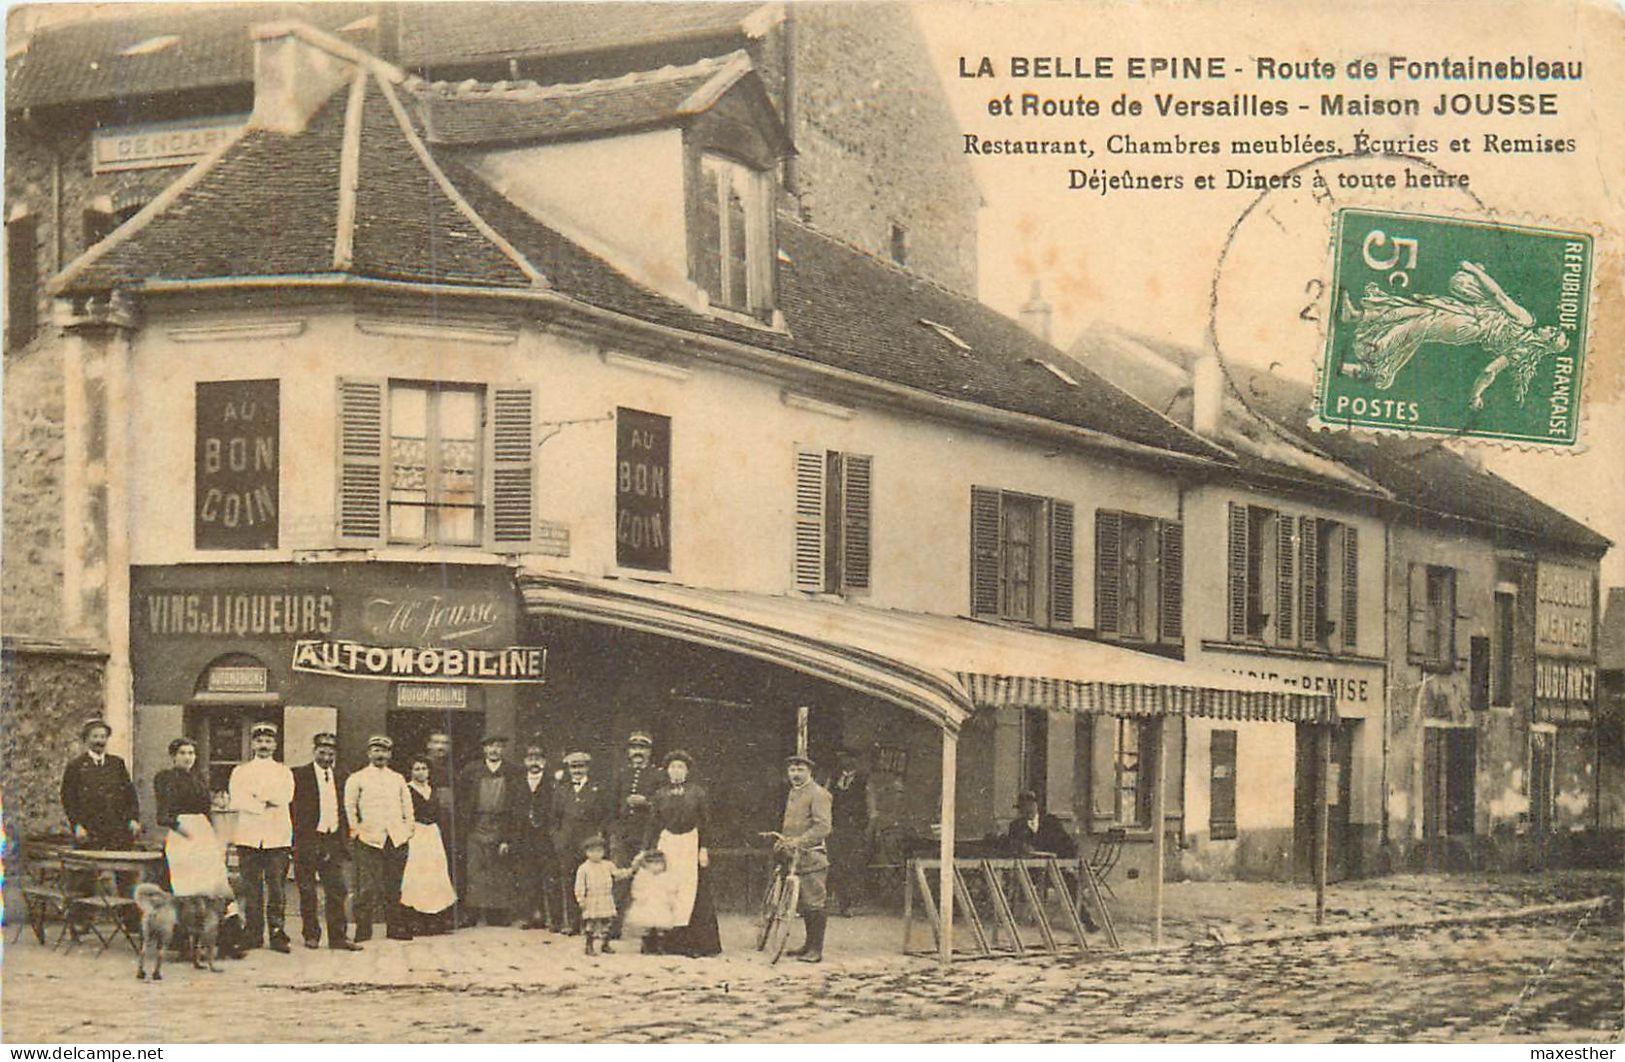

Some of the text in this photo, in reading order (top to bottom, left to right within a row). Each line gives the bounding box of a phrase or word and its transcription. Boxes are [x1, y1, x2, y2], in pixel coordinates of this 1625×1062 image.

[223, 401, 257, 422] AU
[1336, 396, 1419, 422] POSTES
[206, 436, 274, 473] BON
[631, 429, 654, 449] AU
[619, 461, 664, 499] BON
[201, 486, 276, 528] COIN
[617, 506, 665, 548] COIN
[148, 595, 200, 633] VINS
[212, 595, 334, 637] LIQUEURS
[298, 644, 541, 676] AUTOMOBILINE
